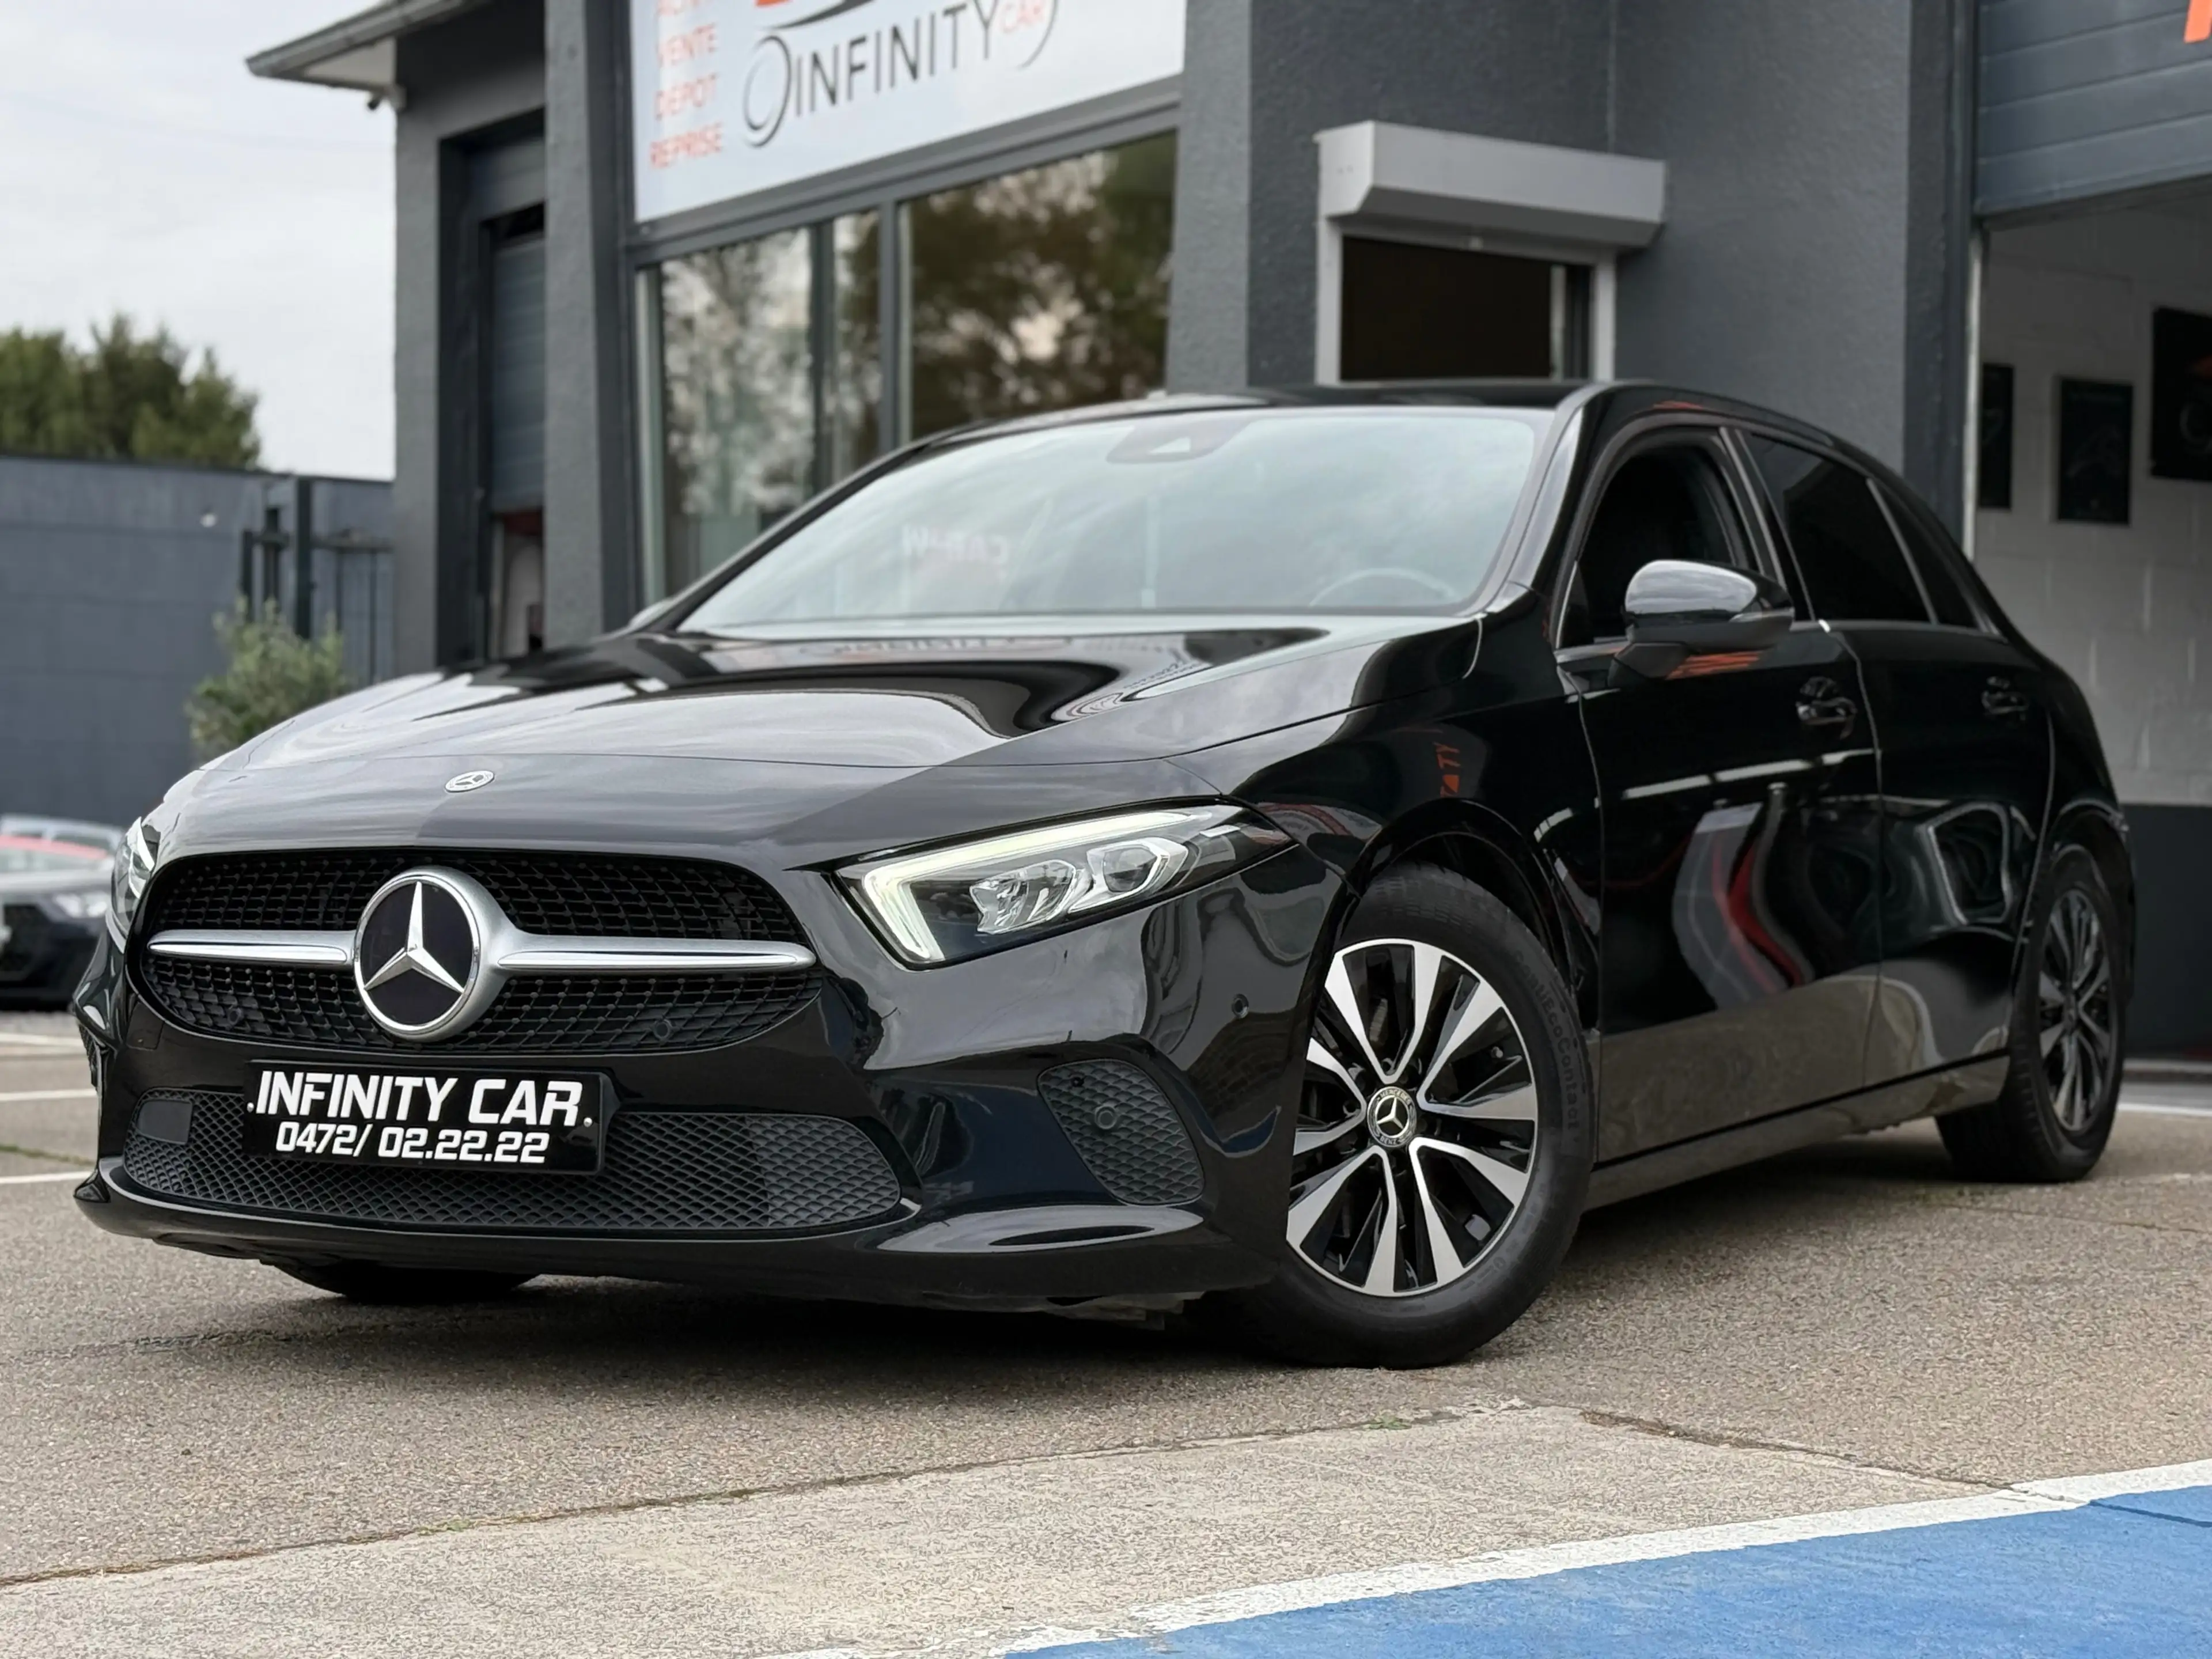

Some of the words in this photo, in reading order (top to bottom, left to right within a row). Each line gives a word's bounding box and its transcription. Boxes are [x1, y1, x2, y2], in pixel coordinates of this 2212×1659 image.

[656, 23, 718, 67] VENTE
[794, 0, 999, 118] INFINITY
[649, 121, 722, 169] REPRISE
[256, 1070, 459, 1122] INFINITY
[468, 1078, 583, 1127] CAR
[275, 1121, 374, 1157] 0472/
[377, 1126, 550, 1164] 02.22.22
